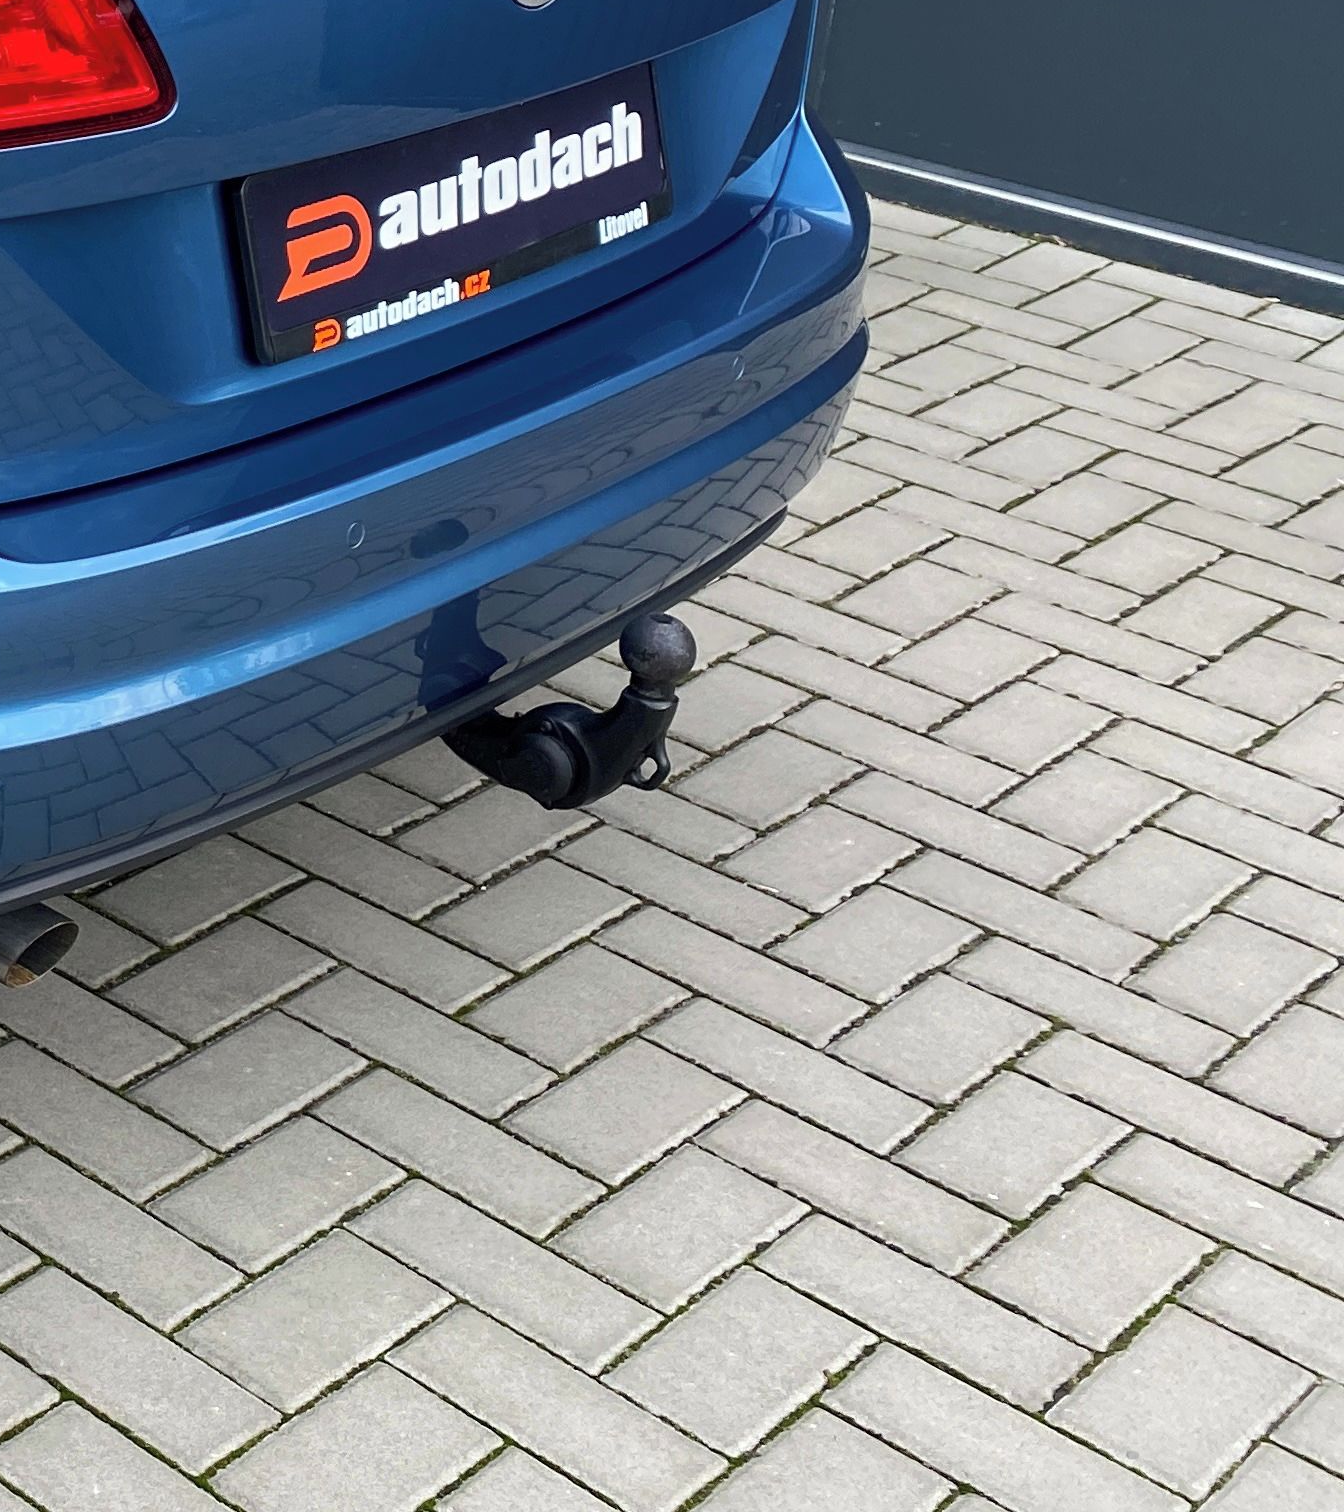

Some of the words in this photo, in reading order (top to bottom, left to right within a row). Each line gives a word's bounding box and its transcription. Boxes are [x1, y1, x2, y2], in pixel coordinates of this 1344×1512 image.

[378, 100, 643, 251] autodach
[598, 201, 649, 245] Litovel
[345, 269, 492, 340] autodach.cz
